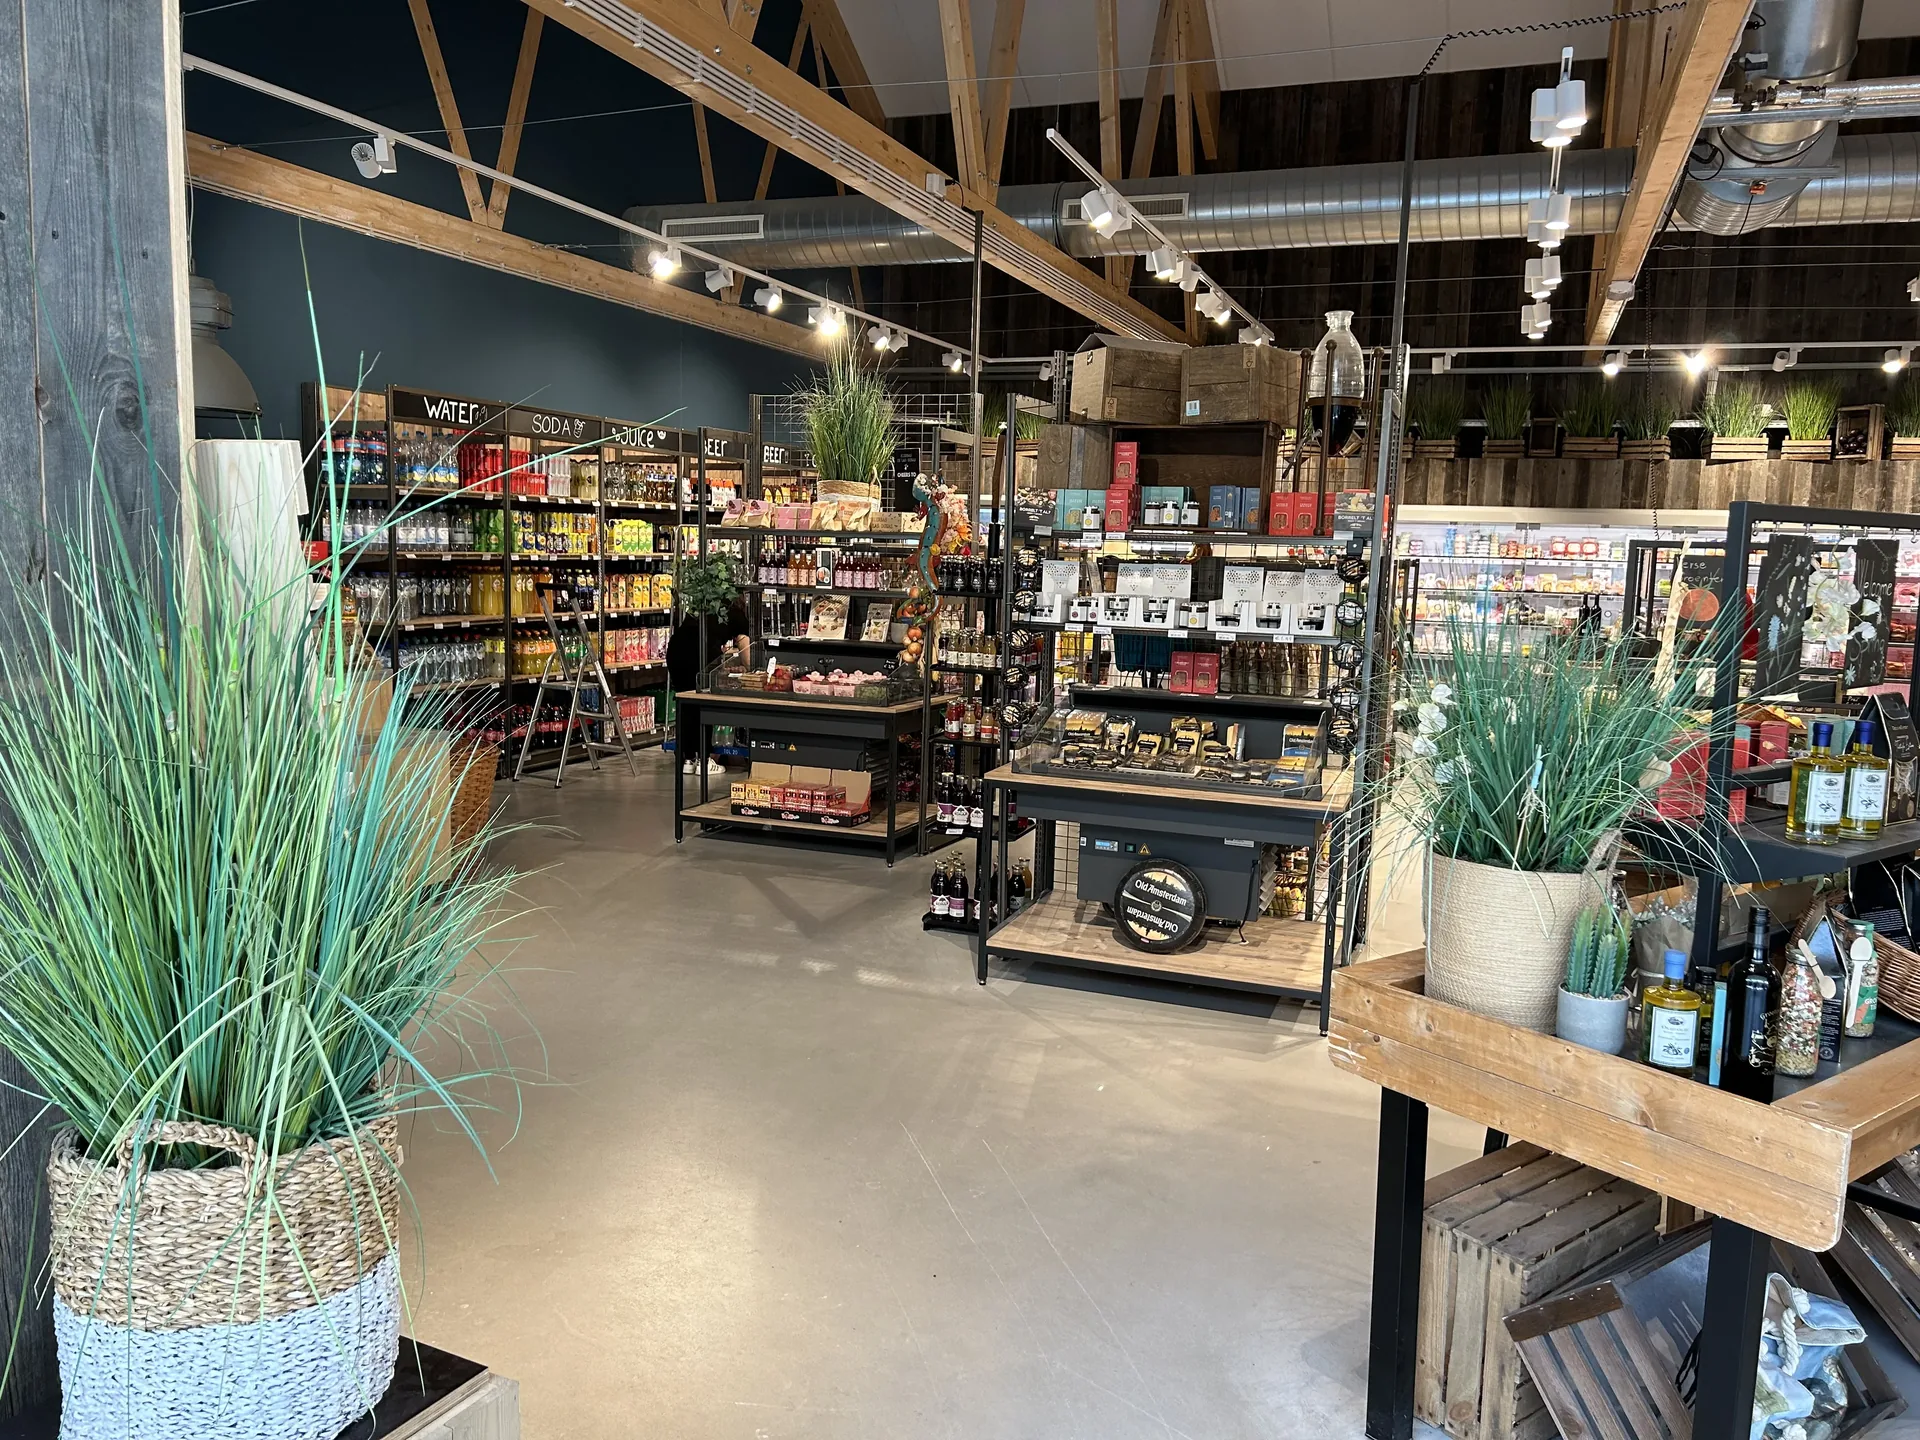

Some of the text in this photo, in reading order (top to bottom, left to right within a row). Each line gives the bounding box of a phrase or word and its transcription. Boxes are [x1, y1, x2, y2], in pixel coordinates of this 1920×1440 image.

[532, 414, 571, 435] SODA
[1683, 572, 1724, 583] roente
[1857, 558, 1893, 597] Welcome
[1134, 879, 1187, 907] Old Amsterdam
[1126, 905, 1179, 933] Old Amsterdam
